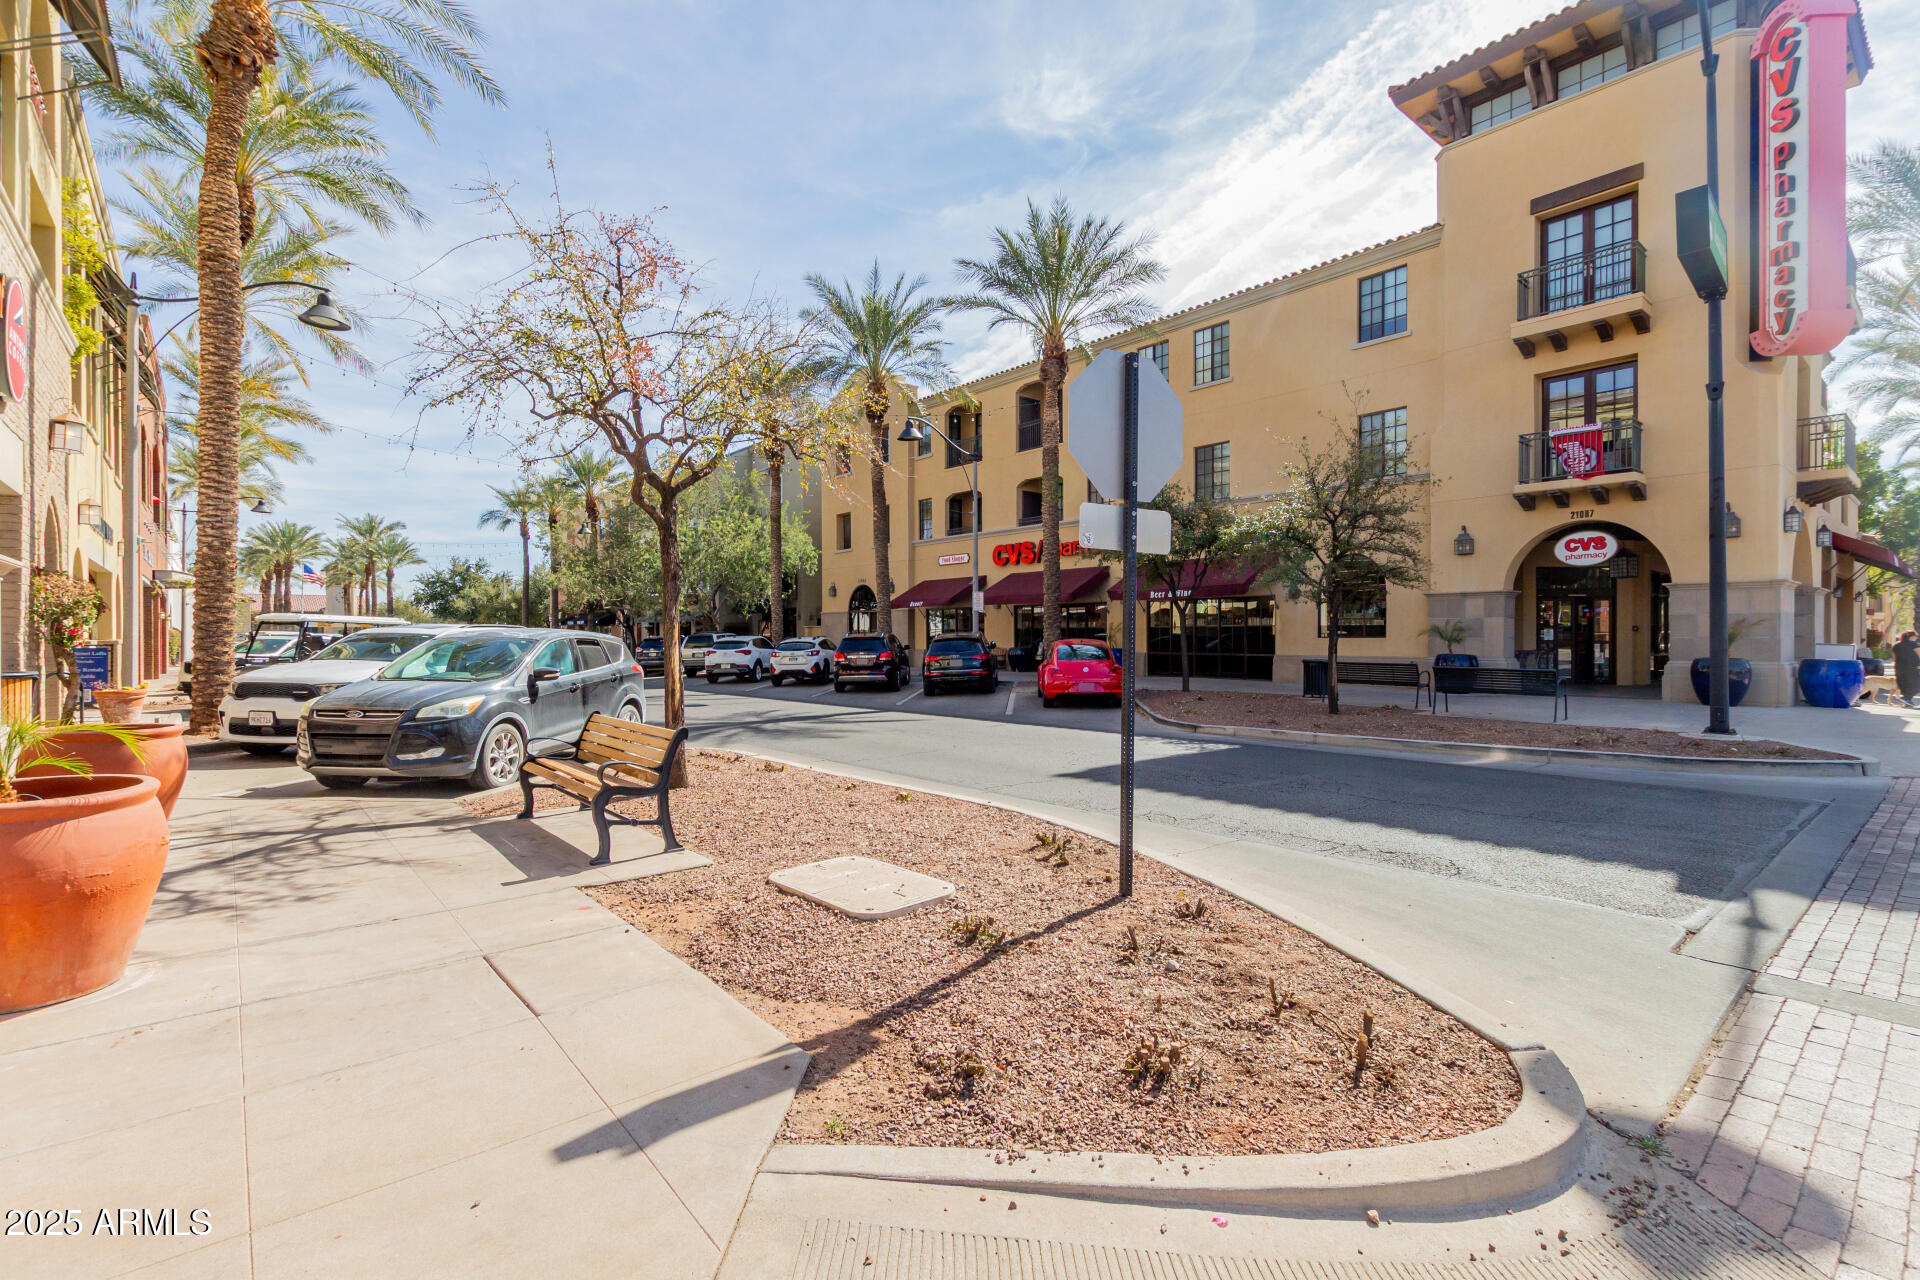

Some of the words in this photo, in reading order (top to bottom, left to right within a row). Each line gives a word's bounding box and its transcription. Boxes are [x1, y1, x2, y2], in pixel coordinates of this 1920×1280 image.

[1769, 26, 1801, 133] CVS
[1570, 509, 1595, 520] 21087
[1564, 536, 1607, 552] CVS
[1565, 551, 1608, 561] pharmacy
[1150, 591, 1165, 599] Beer
